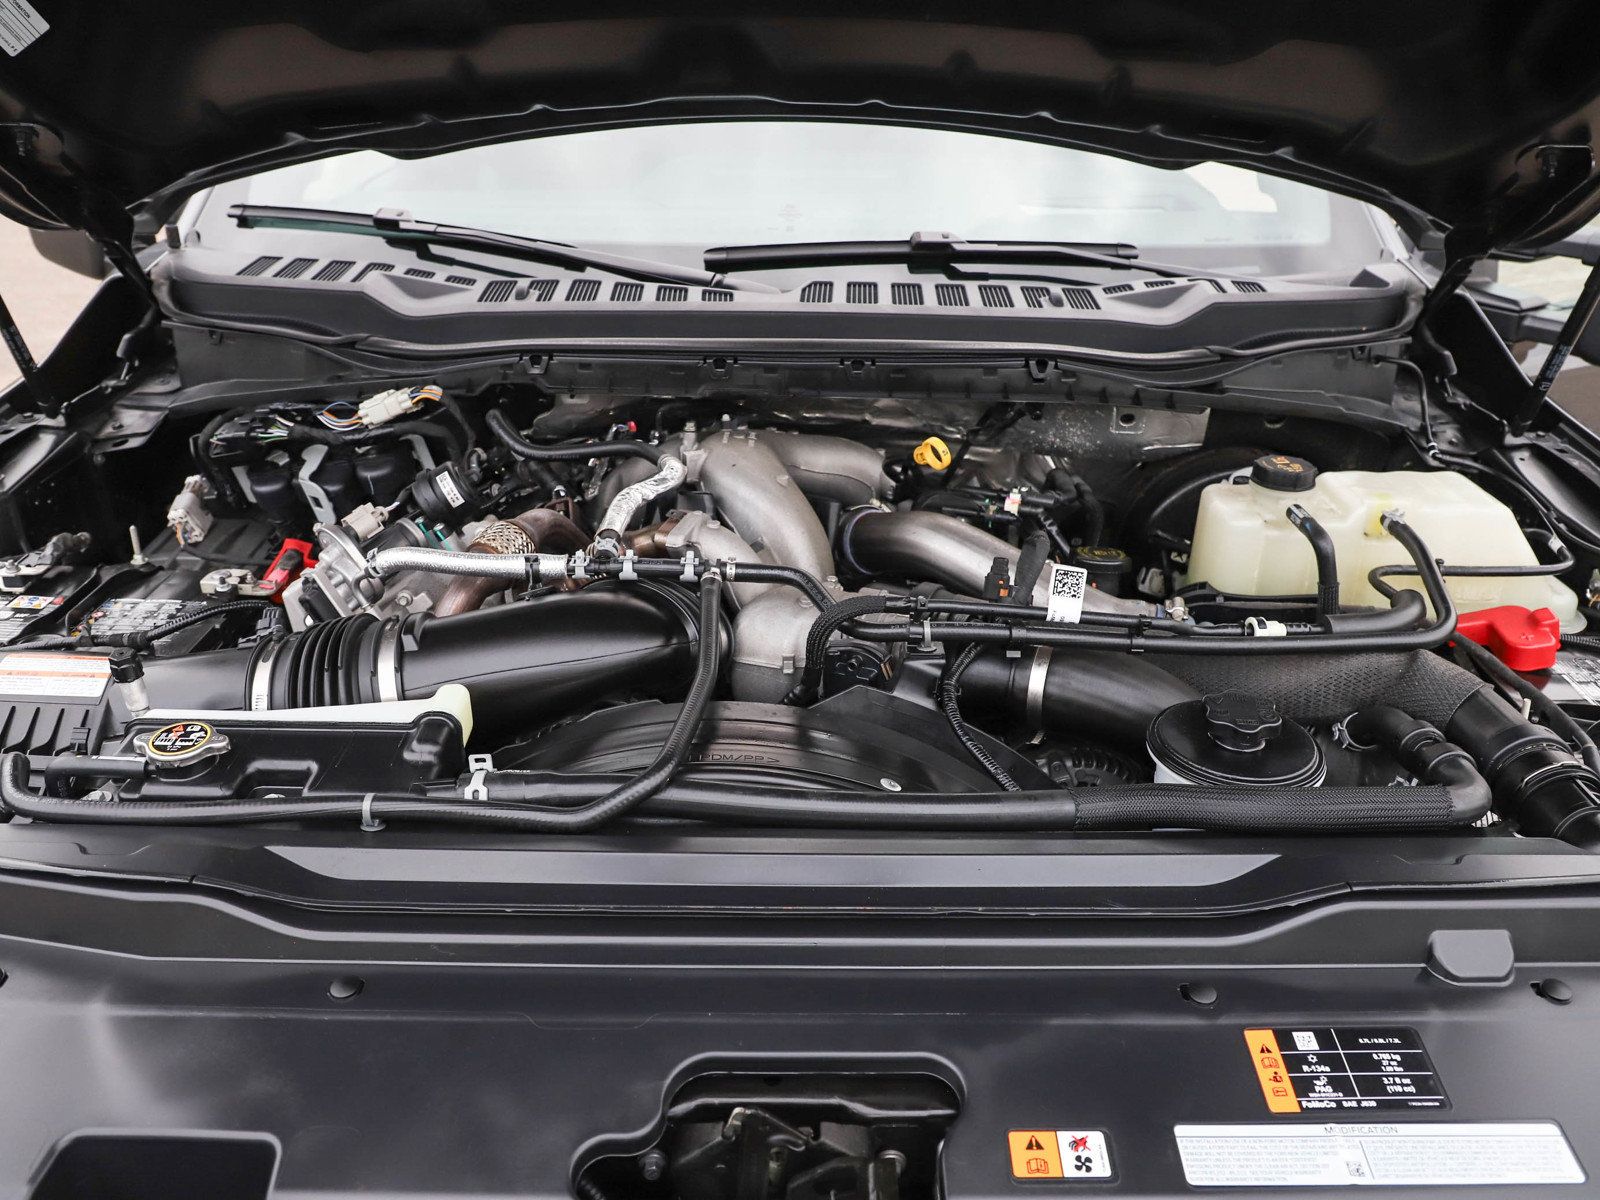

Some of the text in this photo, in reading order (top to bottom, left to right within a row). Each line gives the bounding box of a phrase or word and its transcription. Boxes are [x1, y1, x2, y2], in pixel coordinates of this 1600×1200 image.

[1302, 1065, 1331, 1073] R-134a
[1314, 1085, 1333, 1093] PAG
[1301, 1100, 1337, 1108] FoMoCo
[1324, 1126, 1399, 1134] MODIFICATION
